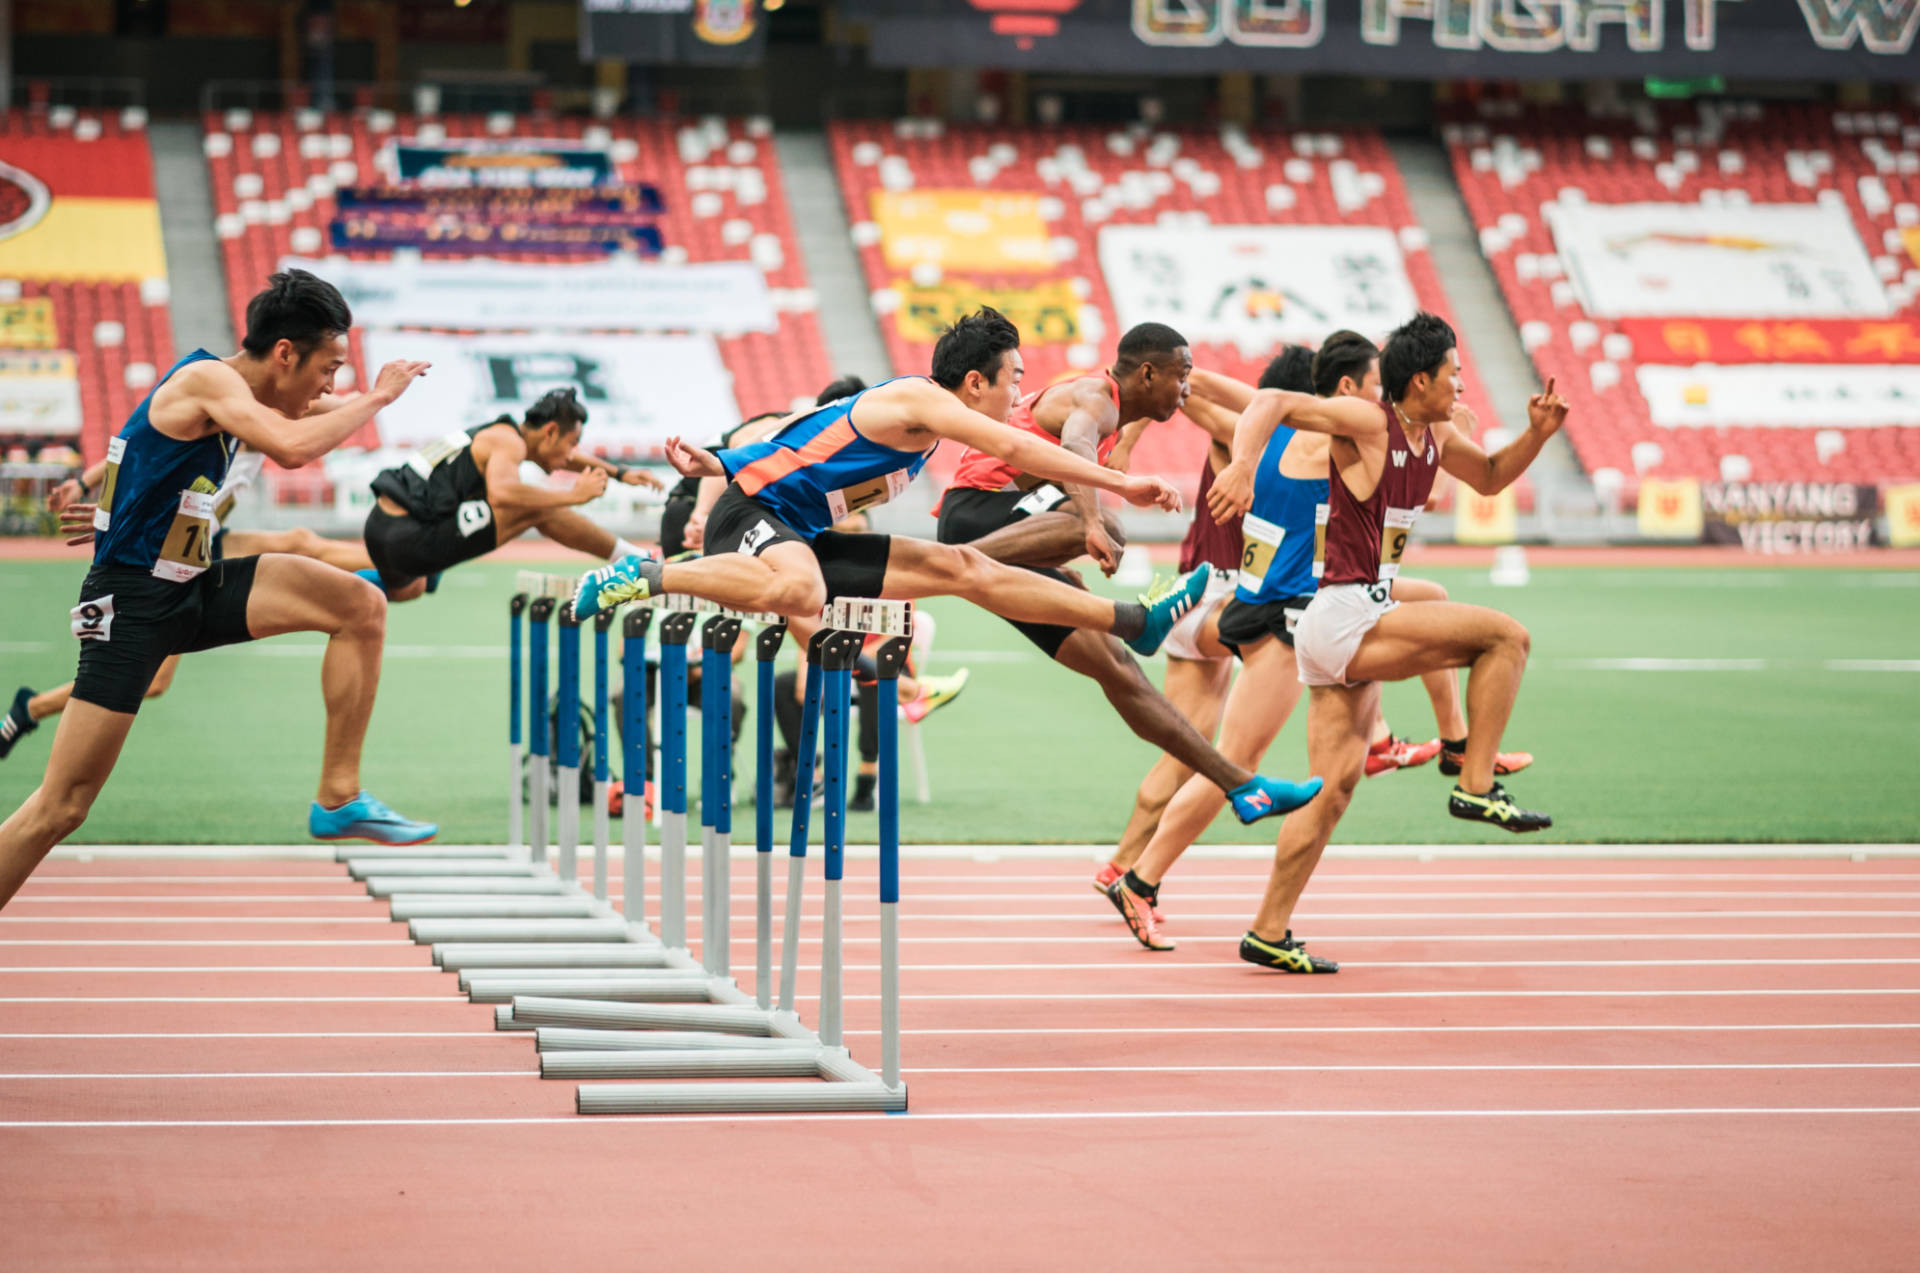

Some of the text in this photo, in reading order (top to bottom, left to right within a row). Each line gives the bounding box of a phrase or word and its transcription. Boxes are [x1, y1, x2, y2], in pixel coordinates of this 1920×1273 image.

[1131, 0, 1325, 47] GO
[1361, 0, 1745, 52] FIGHT
[1391, 449, 1408, 468] W
[1738, 519, 1871, 554] VICTORY
[80, 603, 105, 630] 9
